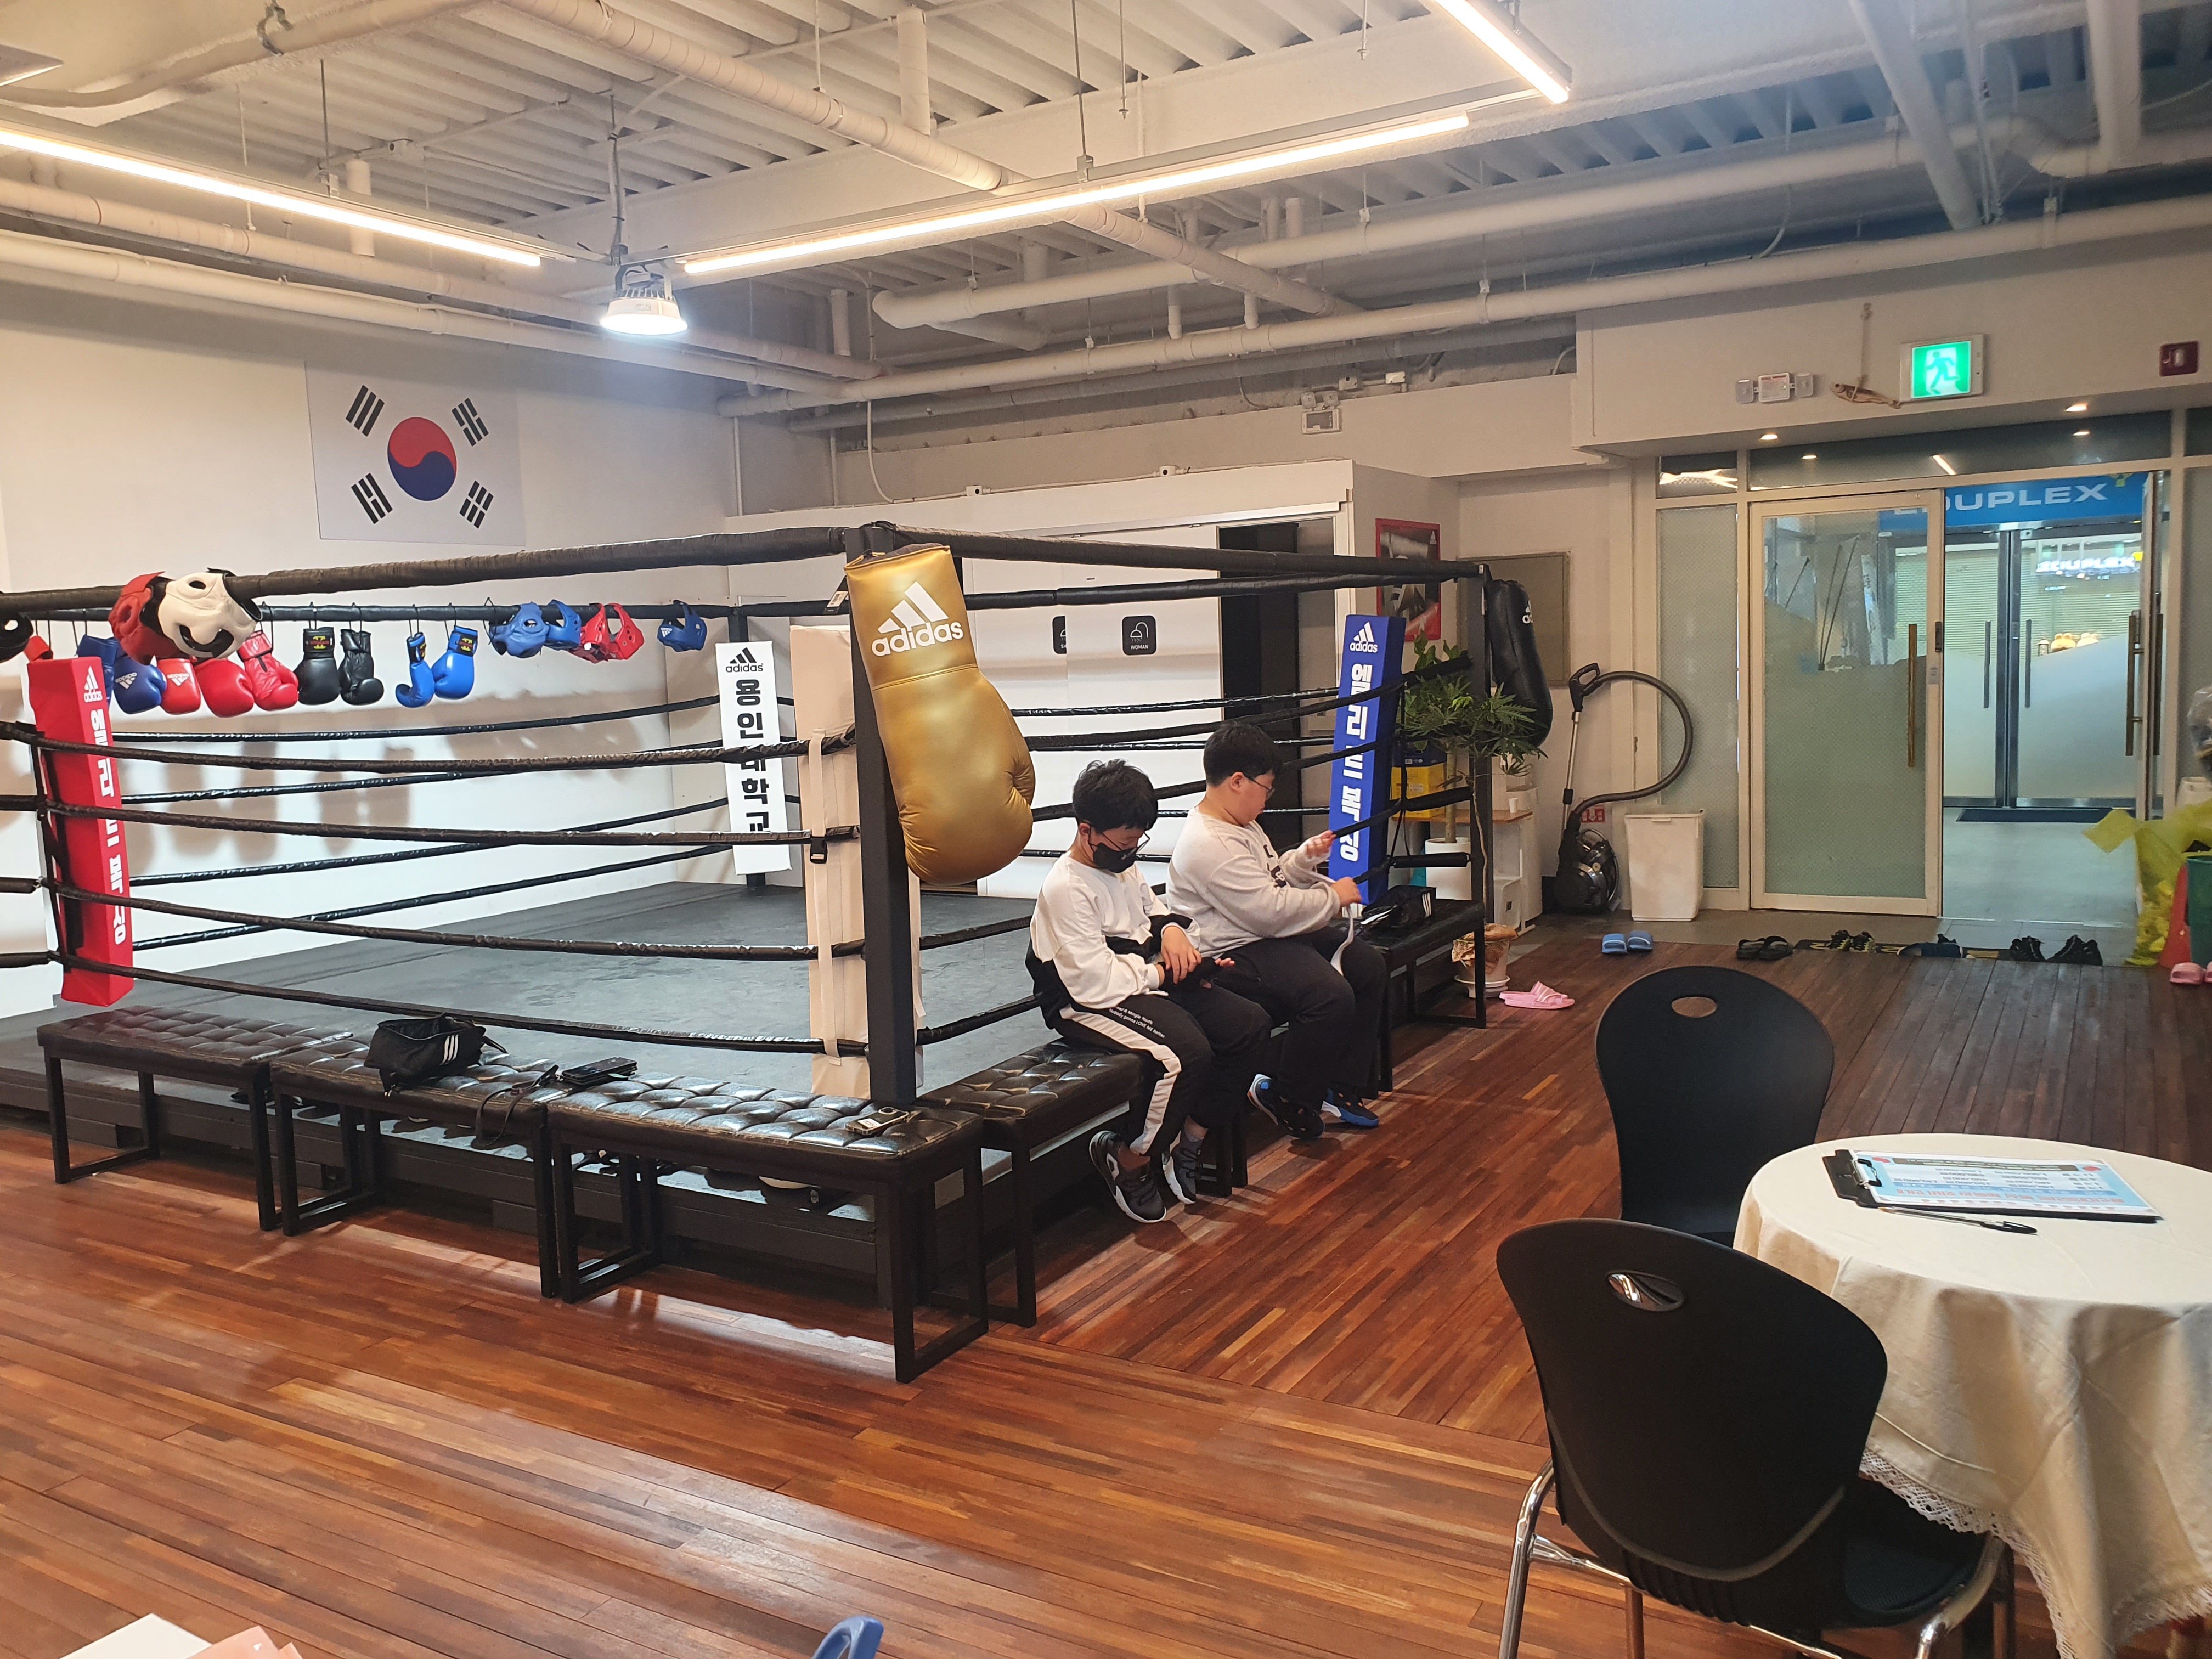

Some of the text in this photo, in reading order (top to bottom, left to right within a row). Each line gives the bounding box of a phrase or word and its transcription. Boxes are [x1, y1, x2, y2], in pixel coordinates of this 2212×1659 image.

[1894, 482, 2108, 514] UPLEX
[872, 621, 964, 657] adidas
[1350, 641, 1378, 653] adidas
[725, 663, 764, 673] adidas
[83, 689, 103, 703] adidas
[1153, 1029, 1165, 1038] better
